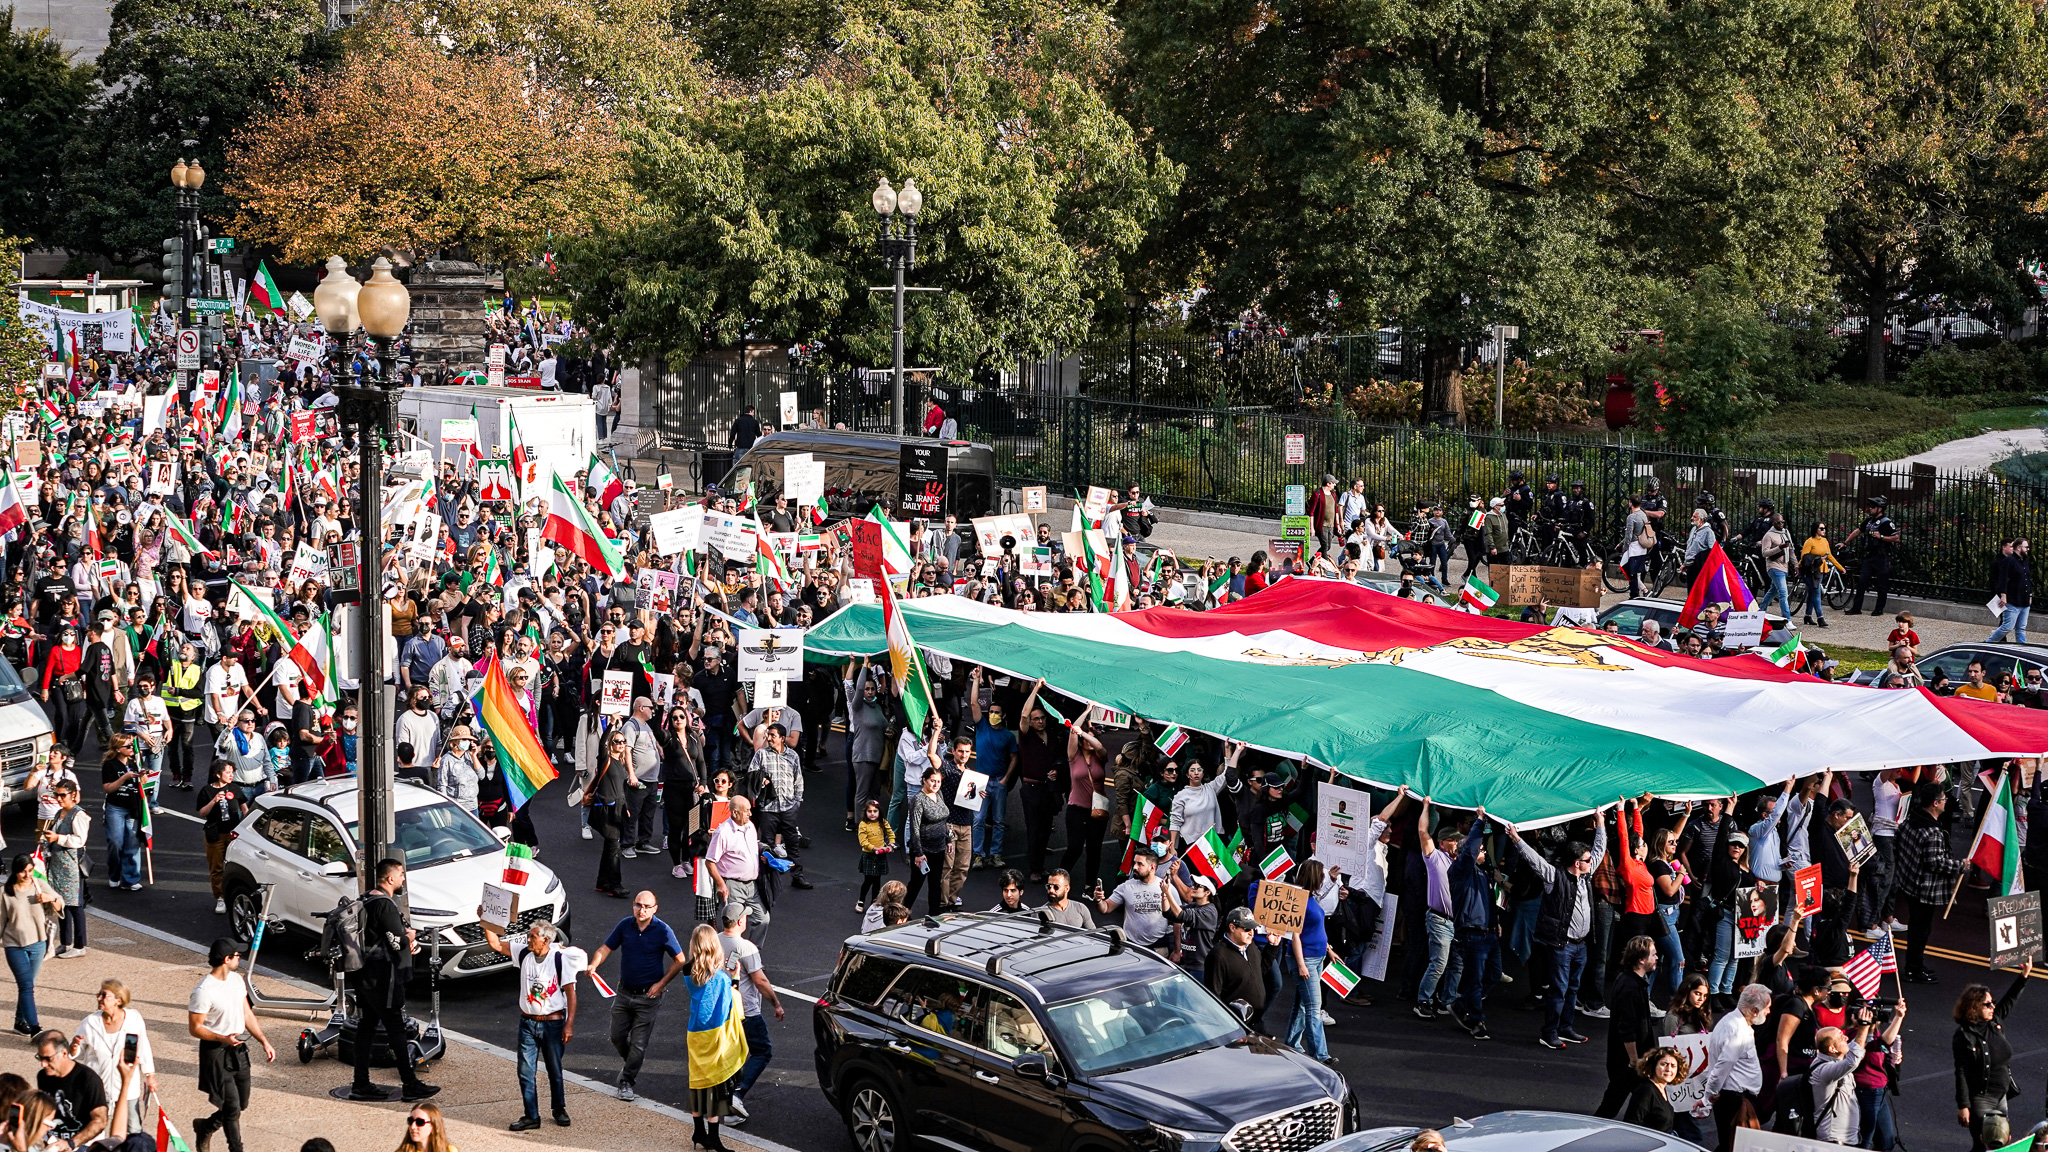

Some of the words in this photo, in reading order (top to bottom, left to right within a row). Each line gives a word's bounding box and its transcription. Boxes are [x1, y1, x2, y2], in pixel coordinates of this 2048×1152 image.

[197, 300, 225, 310] CONSTITUTION
[294, 340, 316, 351] WOMEN
[289, 352, 314, 363] LIBERTY
[916, 495, 940, 503] IRAN'S
[903, 502, 922, 510] DAILY
[414, 550, 432, 559] FREEDOM
[1560, 576, 1576, 586] deal
[1511, 595, 1521, 604] But
[1354, 794, 1368, 877] FREEDOM
[1264, 885, 1283, 896] BE
[1286, 889, 1298, 902] the
[482, 901, 508, 917] CHANGE
[1263, 898, 1299, 912] VOICE
[1272, 913, 1302, 927] IRAN
[1670, 1082, 1691, 1102] آزادی
